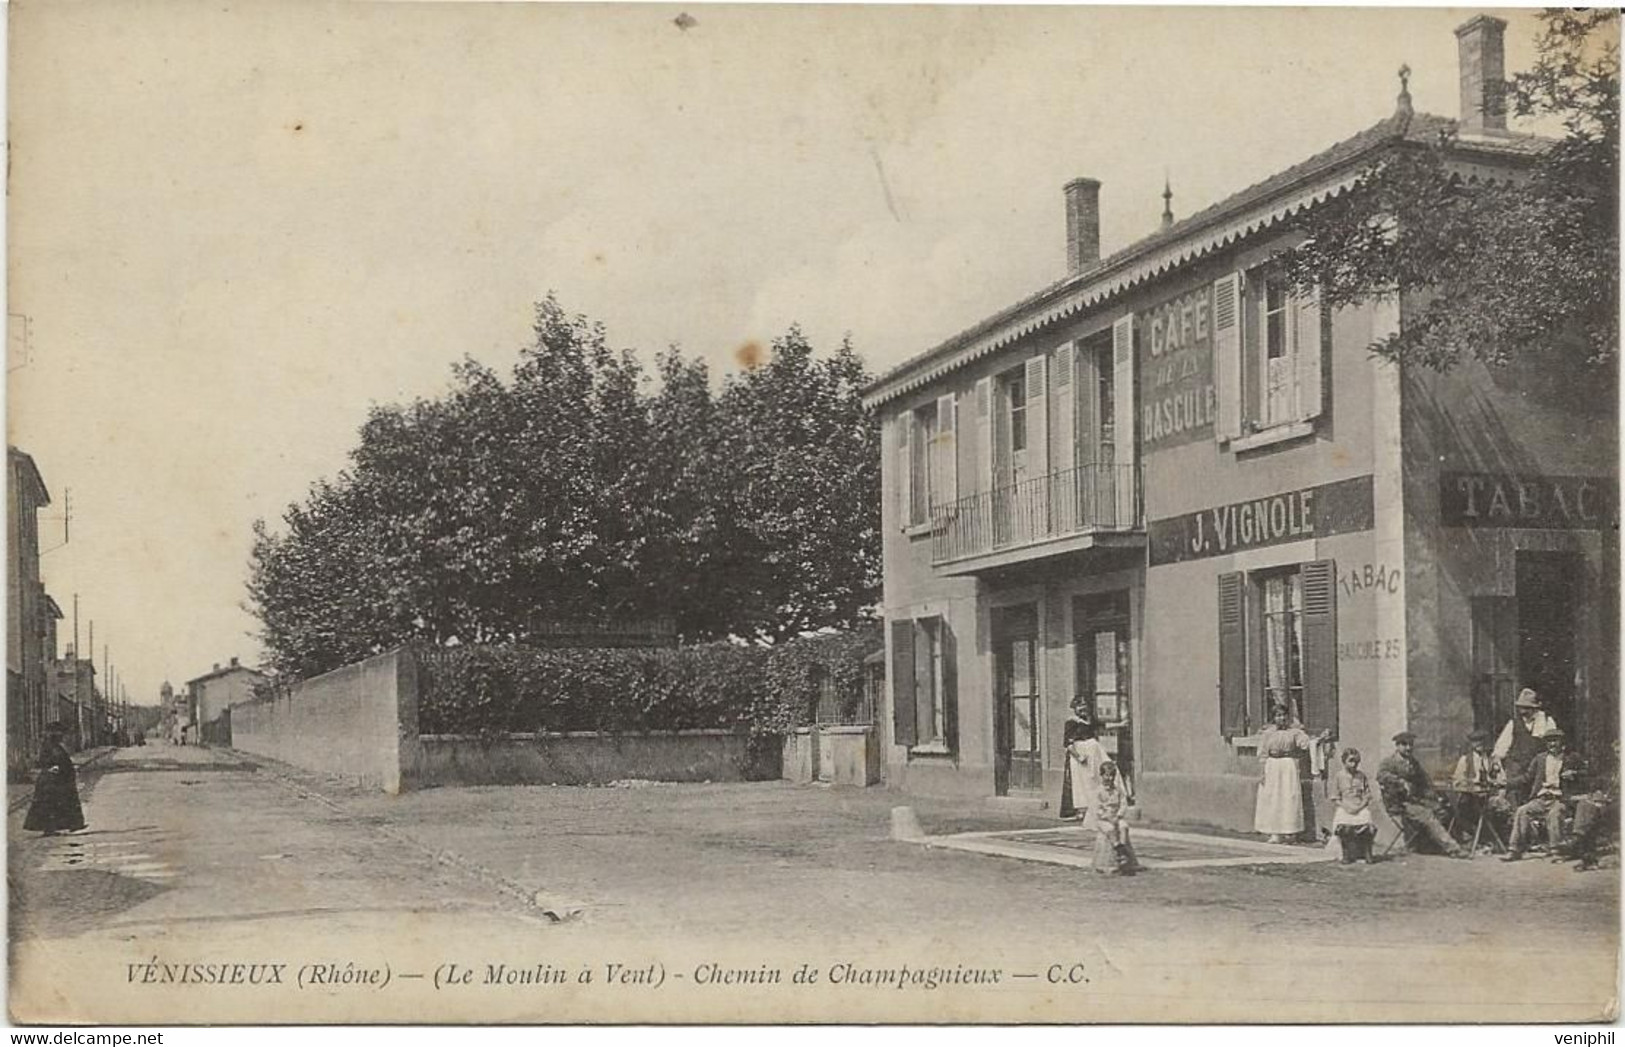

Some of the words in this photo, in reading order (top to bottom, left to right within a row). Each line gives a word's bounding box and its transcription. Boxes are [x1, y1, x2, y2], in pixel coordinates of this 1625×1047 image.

[1143, 384, 1215, 442] BASCULE
[1192, 513, 1210, 553] J.
[1213, 490, 1314, 551] VIGNOLE
[1457, 475, 1599, 521] TABAC
[1339, 564, 1401, 597] TABAC
